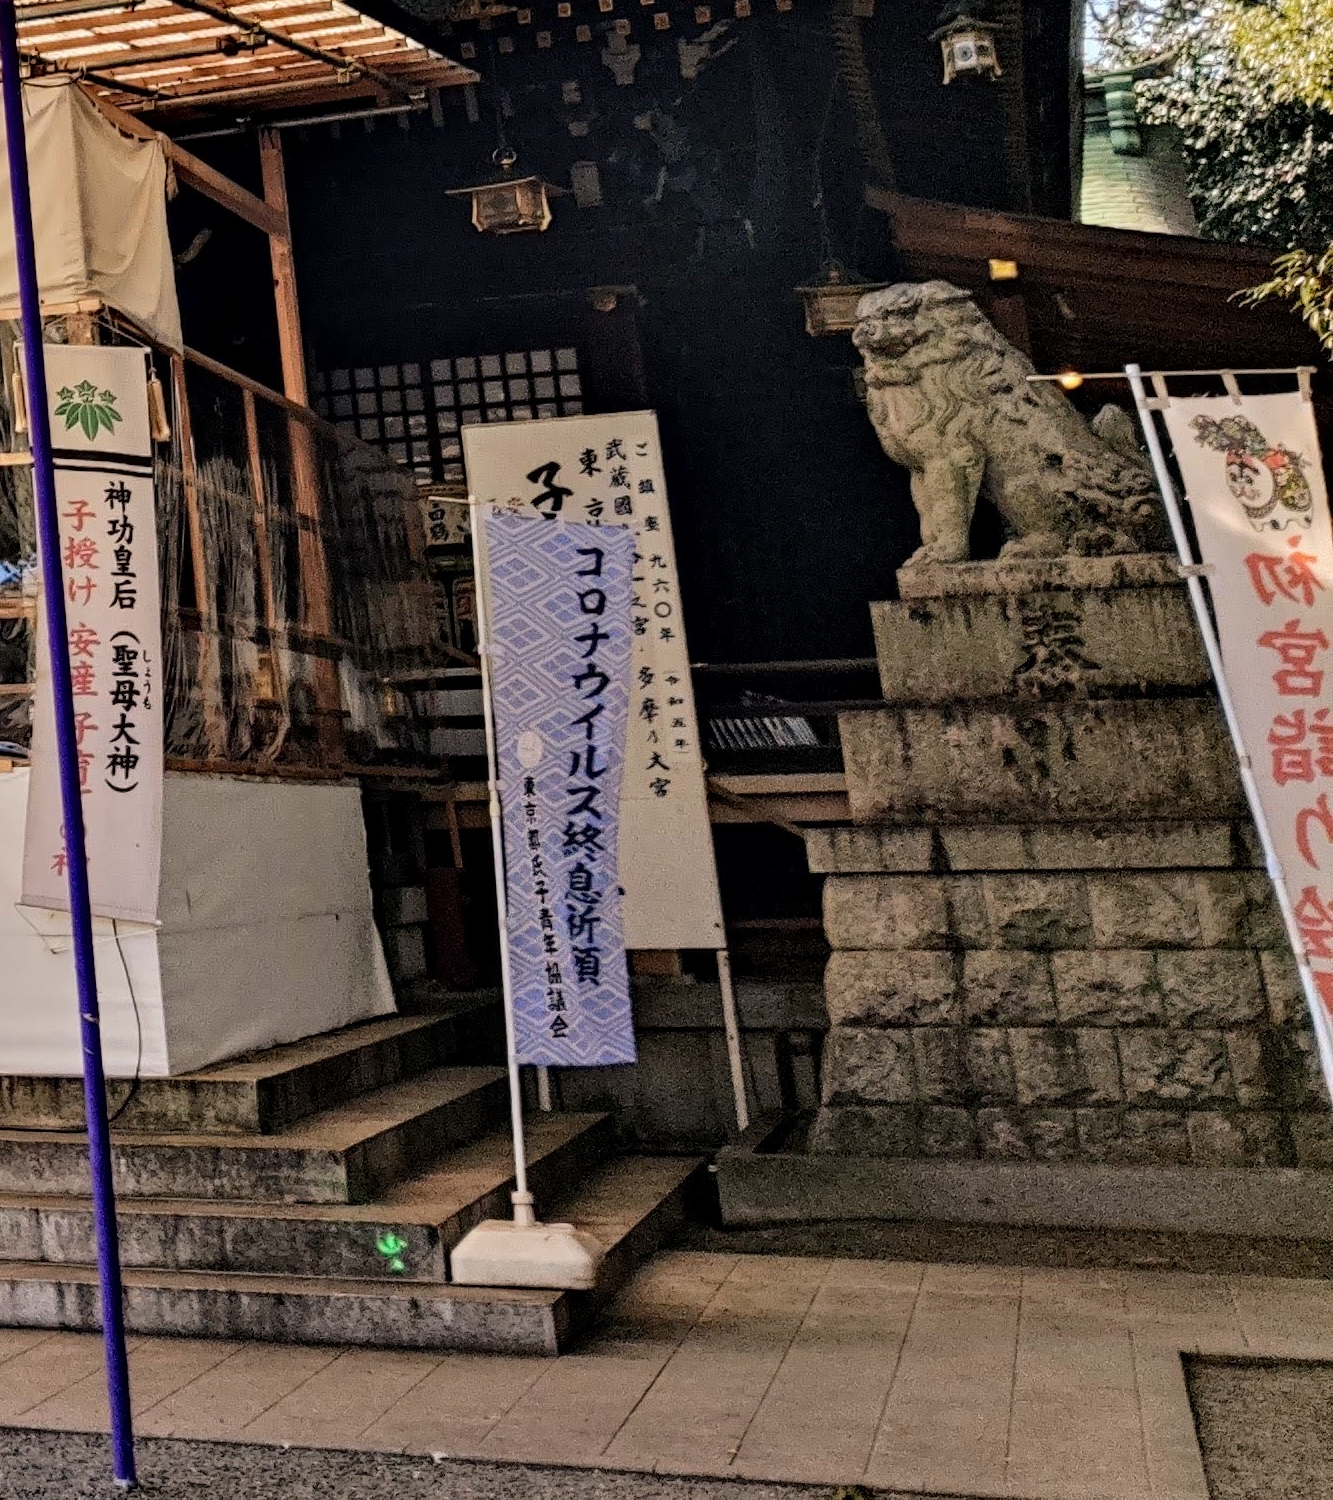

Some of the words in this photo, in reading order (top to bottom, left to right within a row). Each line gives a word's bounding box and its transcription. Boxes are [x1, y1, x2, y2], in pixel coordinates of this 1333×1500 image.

[526, 461, 574, 520] 子
[562, 547, 610, 986] コロナウイルス終息祈願
